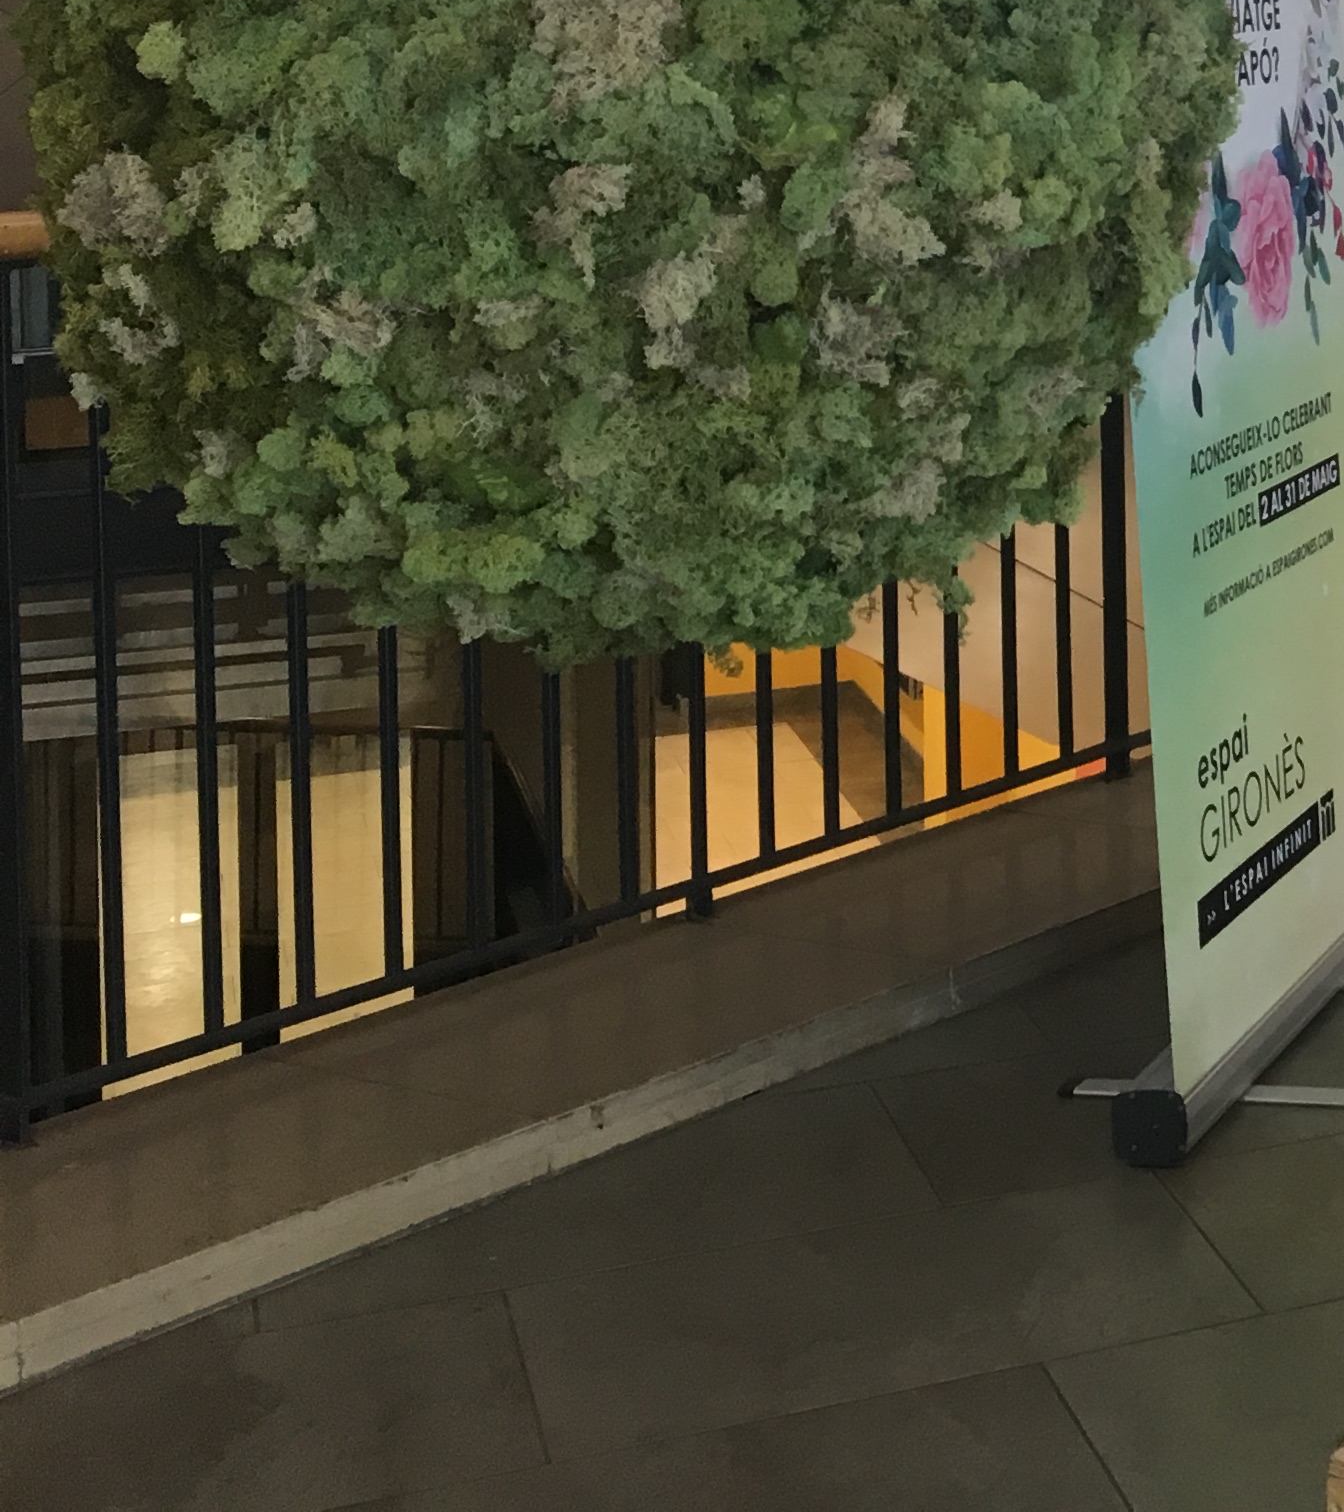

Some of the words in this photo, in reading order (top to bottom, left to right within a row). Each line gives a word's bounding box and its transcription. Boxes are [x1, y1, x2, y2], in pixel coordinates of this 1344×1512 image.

[1190, 415, 1281, 479] ACONSEGUEIX-LO
[1282, 391, 1332, 435] CELEBRANT
[1224, 461, 1257, 499] TEMPS
[1259, 455, 1274, 483] DE
[1275, 440, 1304, 475] FLORS
[1193, 532, 1201, 558] A
[1238, 501, 1257, 532] DEL
[1261, 495, 1269, 520] 2
[1270, 487, 1284, 516] AL
[1285, 481, 1297, 508] 31
[1298, 473, 1311, 501] DE
[1311, 459, 1338, 494] MAIG
[1265, 564, 1272, 581] A
[1198, 712, 1249, 788] espai
[1200, 732, 1306, 863] GIRONÈS
[1223, 855, 1269, 911] L'ESPAI
[1270, 818, 1313, 870] INFINIT
